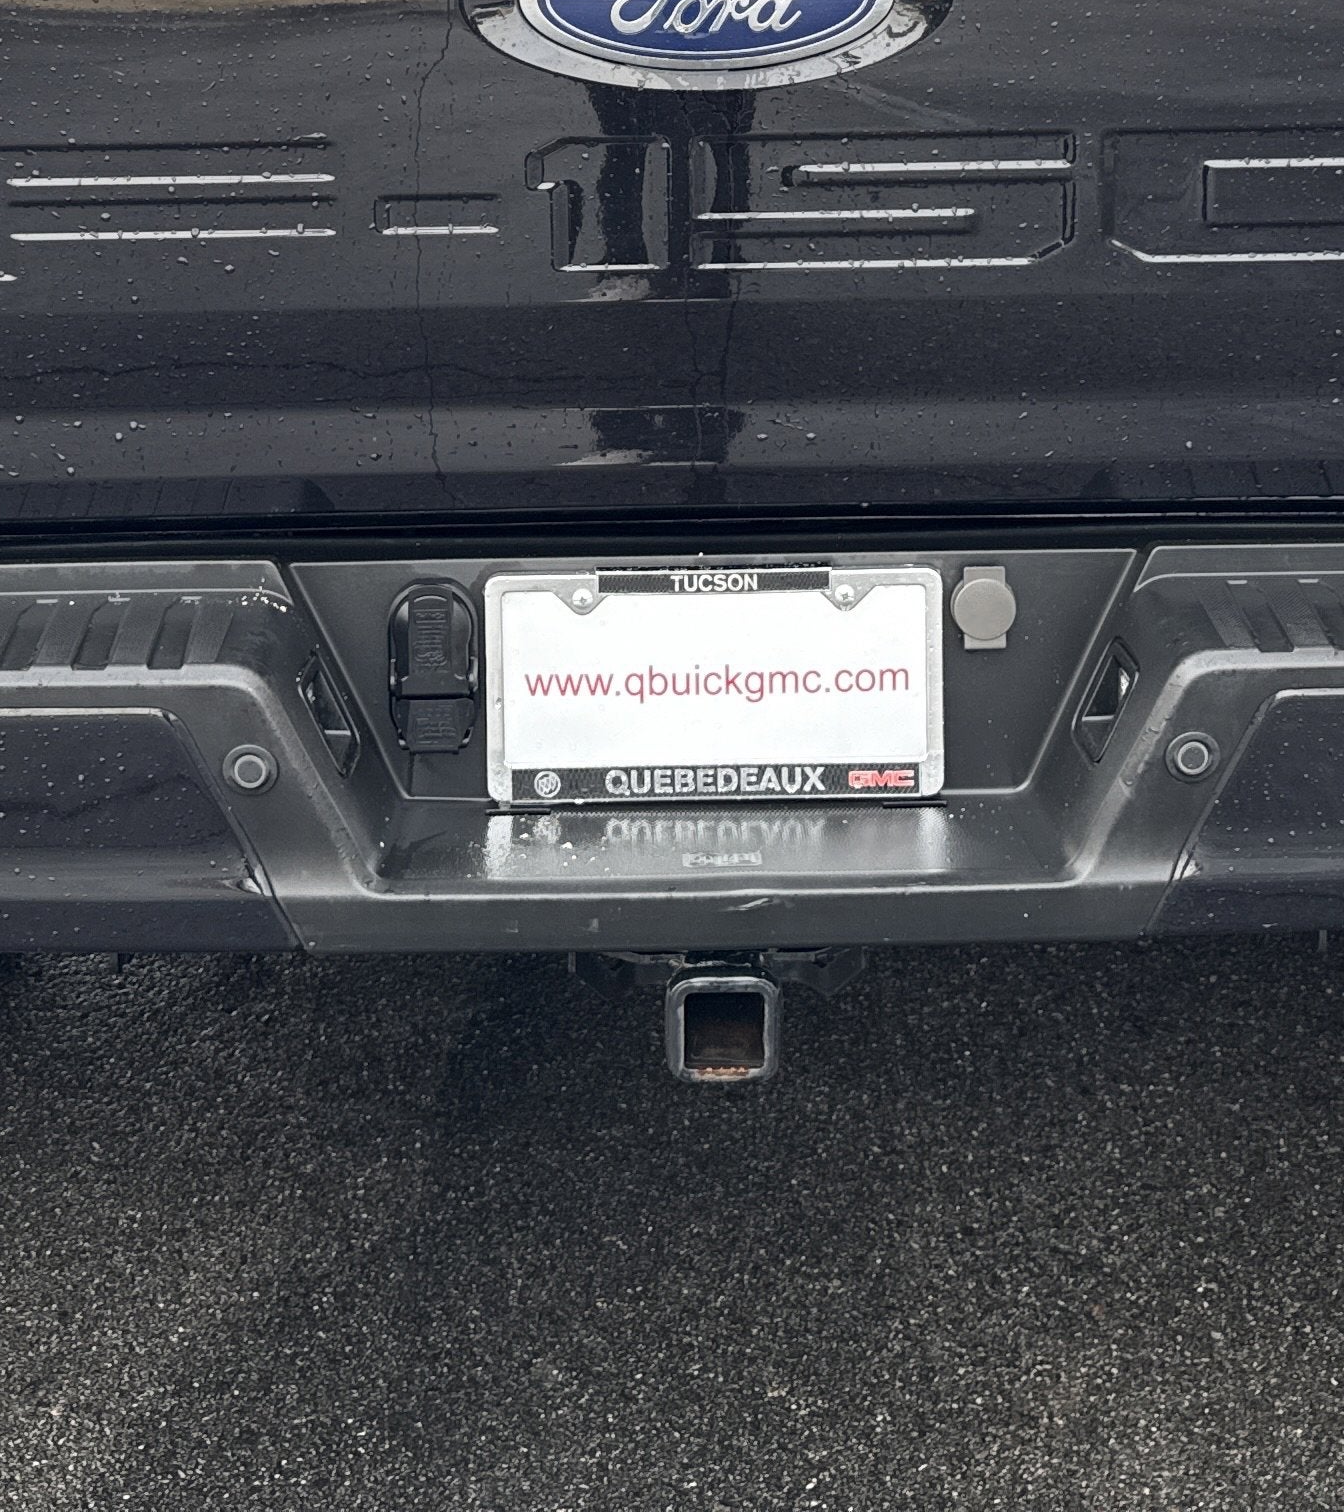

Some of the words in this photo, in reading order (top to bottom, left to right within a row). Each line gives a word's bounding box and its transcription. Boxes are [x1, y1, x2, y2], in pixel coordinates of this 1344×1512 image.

[670, 573, 759, 593] TUCSON
[524, 664, 911, 704] www.qbuickgmc.com
[604, 766, 826, 797] QUEBEDEAUX
[848, 769, 915, 789] GMC
